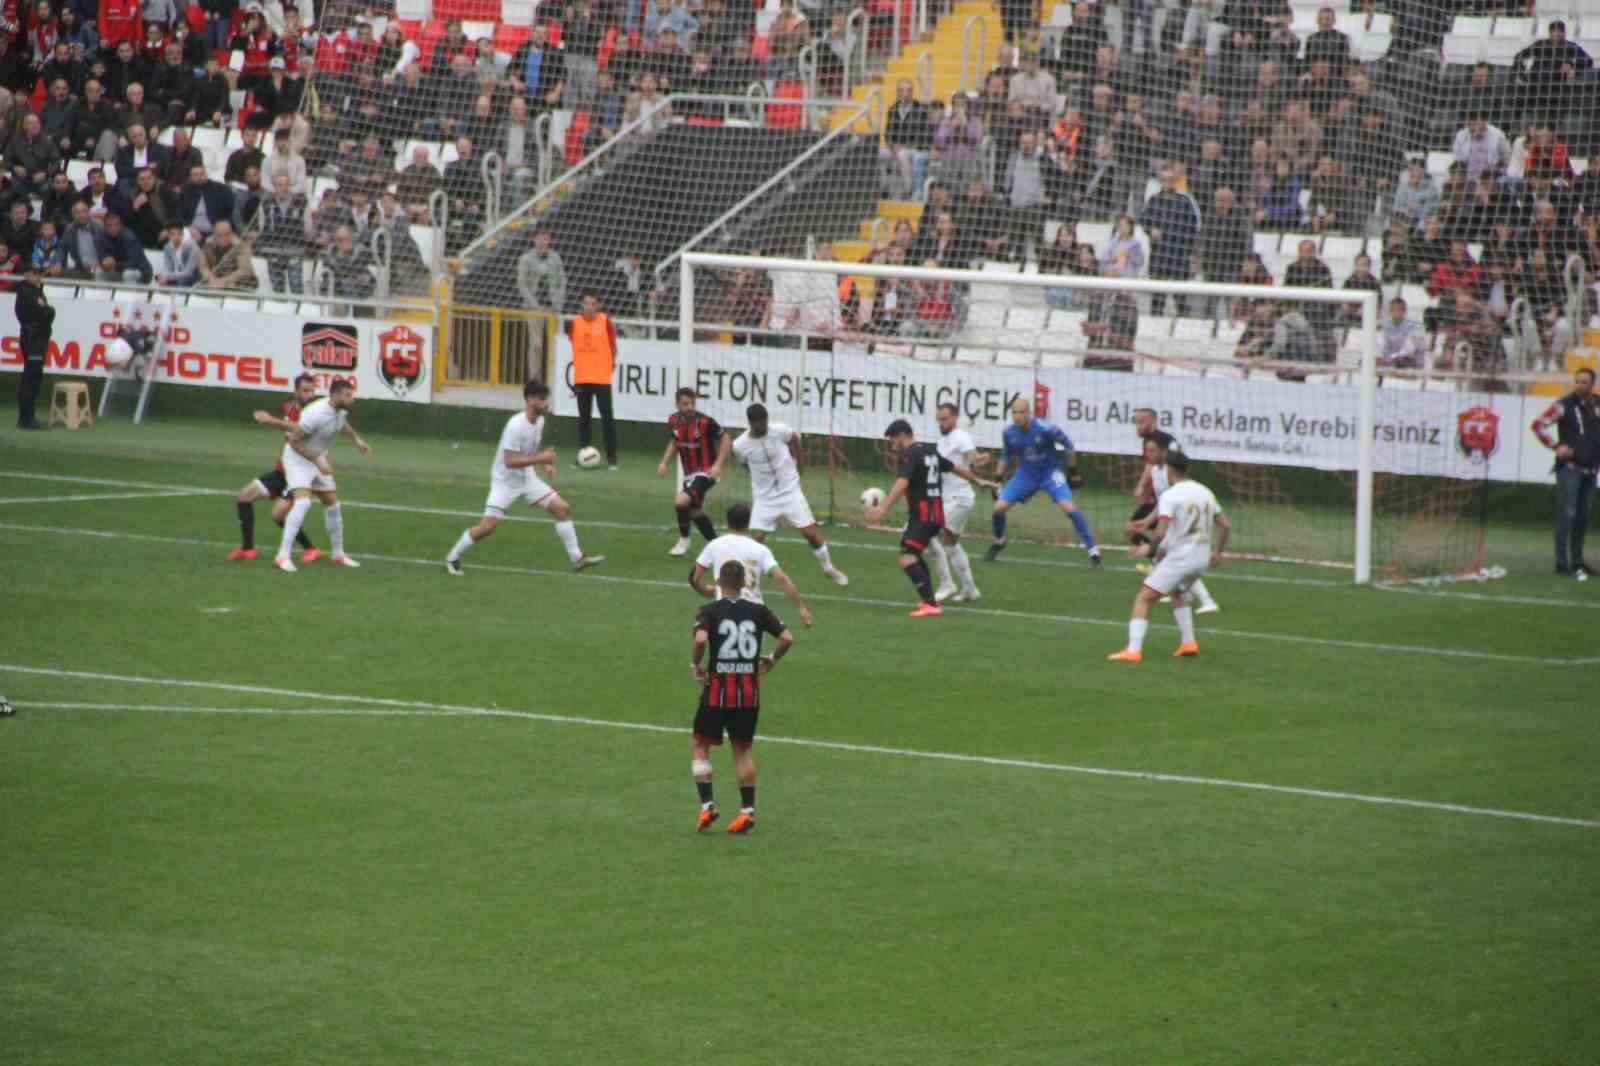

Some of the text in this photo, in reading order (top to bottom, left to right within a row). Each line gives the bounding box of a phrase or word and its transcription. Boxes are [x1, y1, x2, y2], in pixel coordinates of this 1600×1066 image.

[155, 350, 289, 386] HOTEL
[676, 366, 768, 403] ETON
[1066, 399, 1097, 422] Bu
[1181, 406, 1270, 434] Reklam
[717, 618, 759, 660] 26
